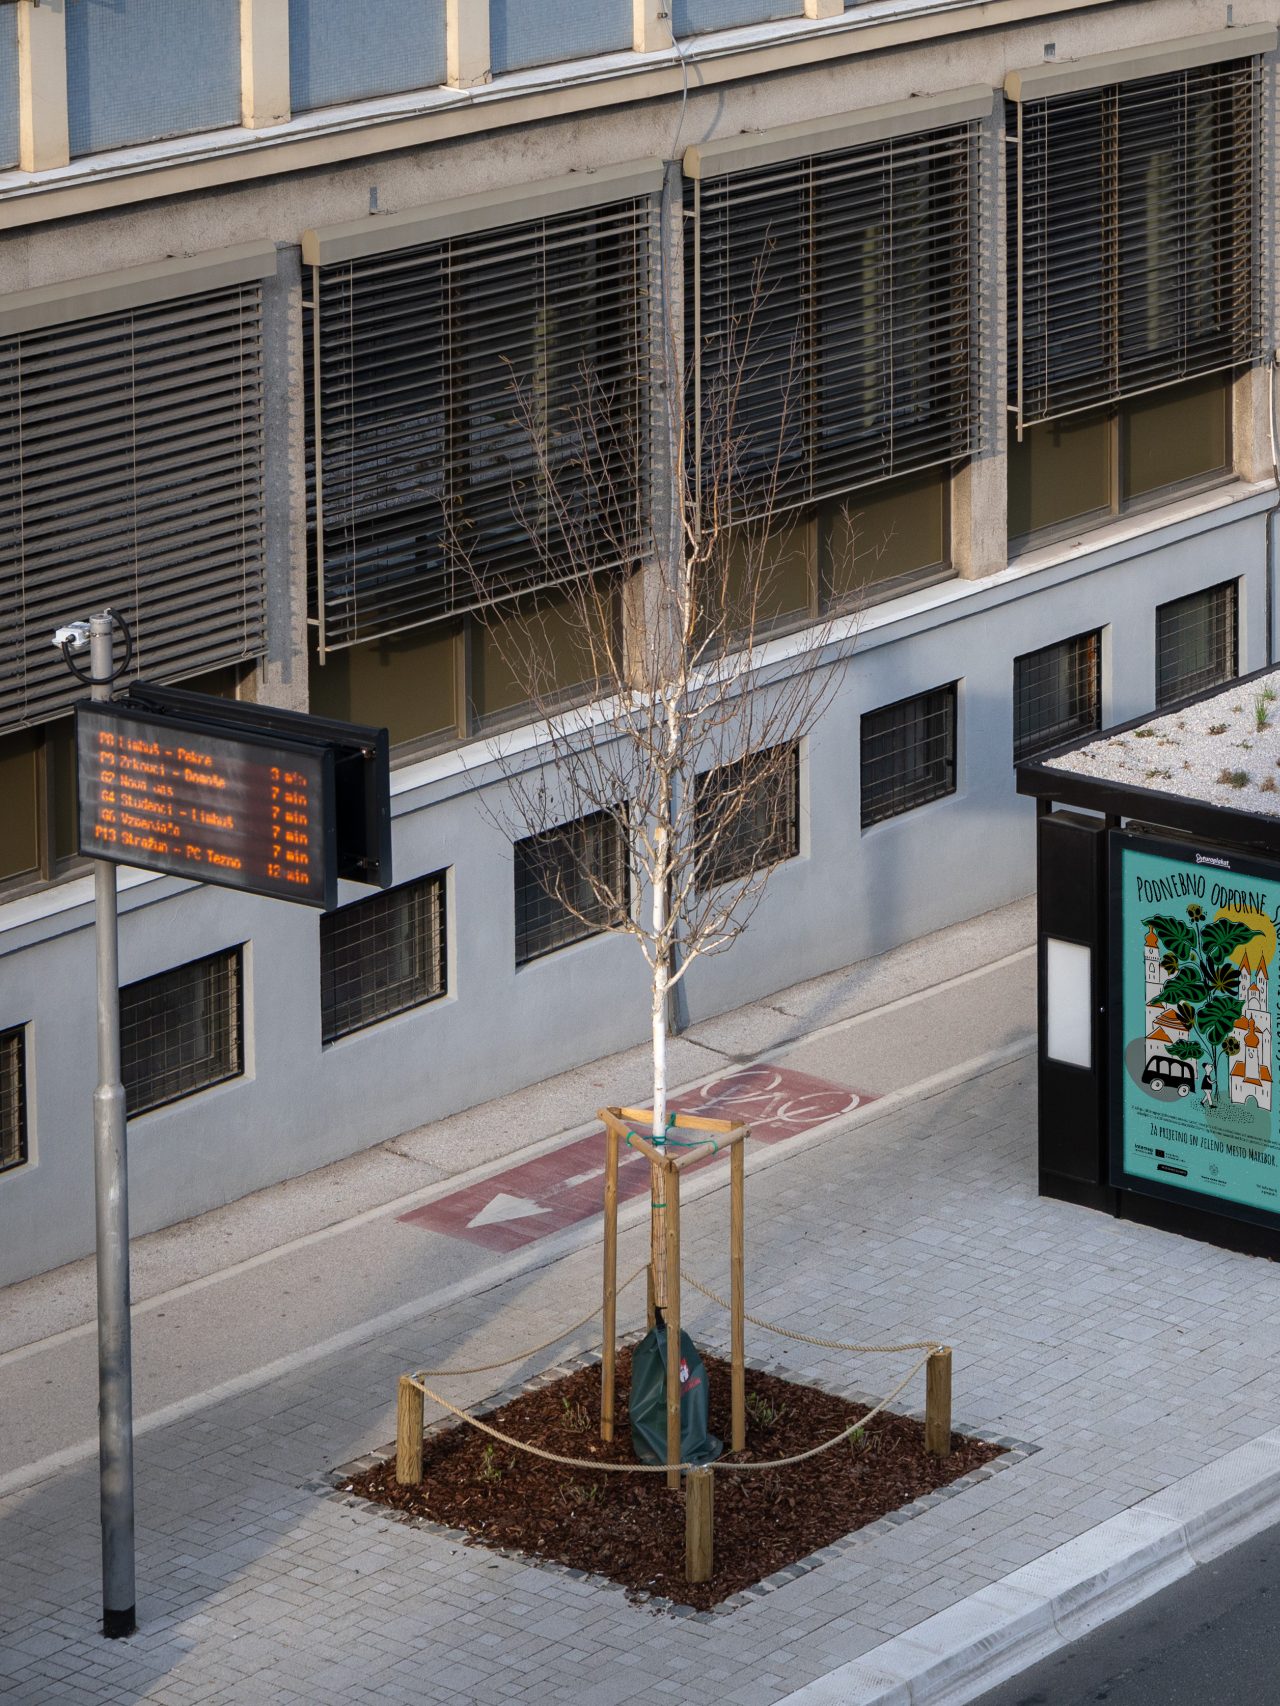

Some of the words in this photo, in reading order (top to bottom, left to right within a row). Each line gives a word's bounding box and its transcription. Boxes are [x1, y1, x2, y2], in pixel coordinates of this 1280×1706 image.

[284, 792, 308, 806] min
[285, 811, 308, 826] min
[286, 830, 308, 846] min
[95, 825, 116, 842] P13
[186, 845, 202, 860] PC
[207, 850, 242, 870] Tezno
[268, 864, 280, 878] 12
[286, 869, 309, 884] min
[286, 850, 308, 864] min
[1136, 872, 1206, 904] PODNEBNO
[1210, 883, 1267, 917] ODPORNE
[1159, 1126, 1188, 1145] PRIJETNO
[1200, 1136, 1224, 1154] ZELENO
[1226, 1144, 1247, 1158] MESTO
